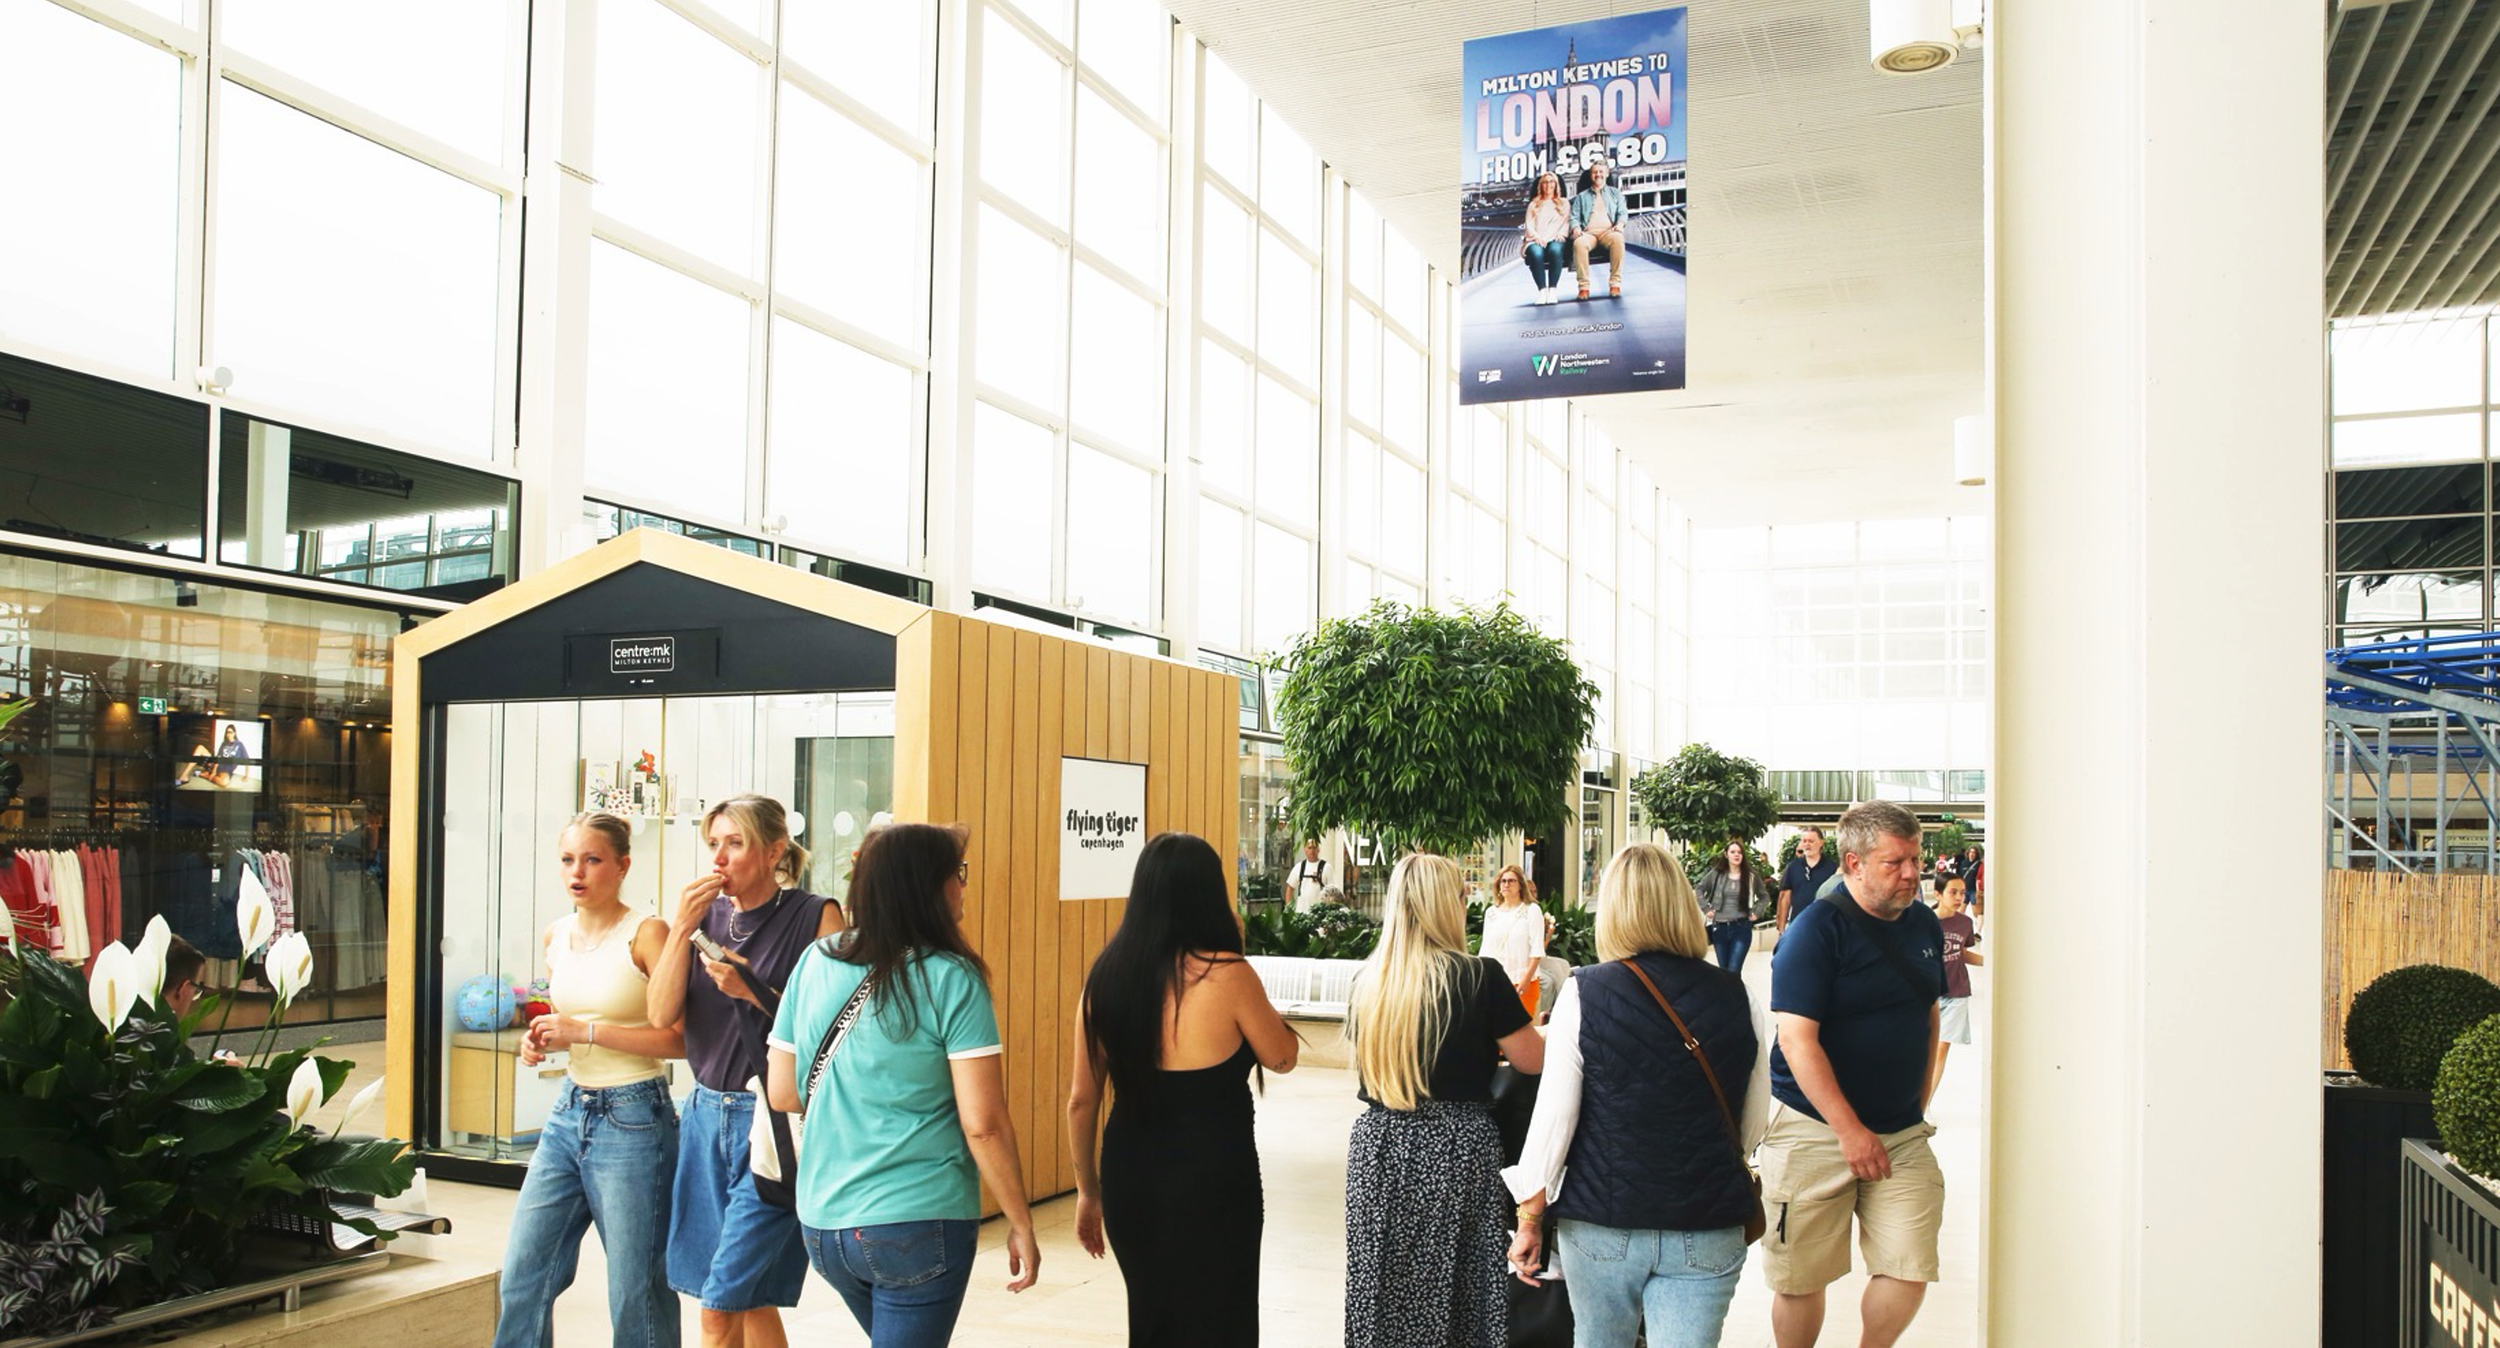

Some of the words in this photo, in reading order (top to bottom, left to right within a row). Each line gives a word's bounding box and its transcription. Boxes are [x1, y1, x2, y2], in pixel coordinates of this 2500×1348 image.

[1482, 72, 1557, 97] MILTON
[1563, 57, 1643, 84] KEYNES
[1648, 54, 1668, 72] TO
[1476, 73, 1672, 153] LONDON
[1481, 149, 1547, 184] FROM
[1560, 359, 1610, 367] Northwestern
[1560, 367, 1588, 375] Railway
[614, 643, 670, 657] centre:mk
[1066, 808, 1104, 837] flying
[1105, 810, 1138, 837] tiger
[1080, 837, 1125, 851] copenhagen
